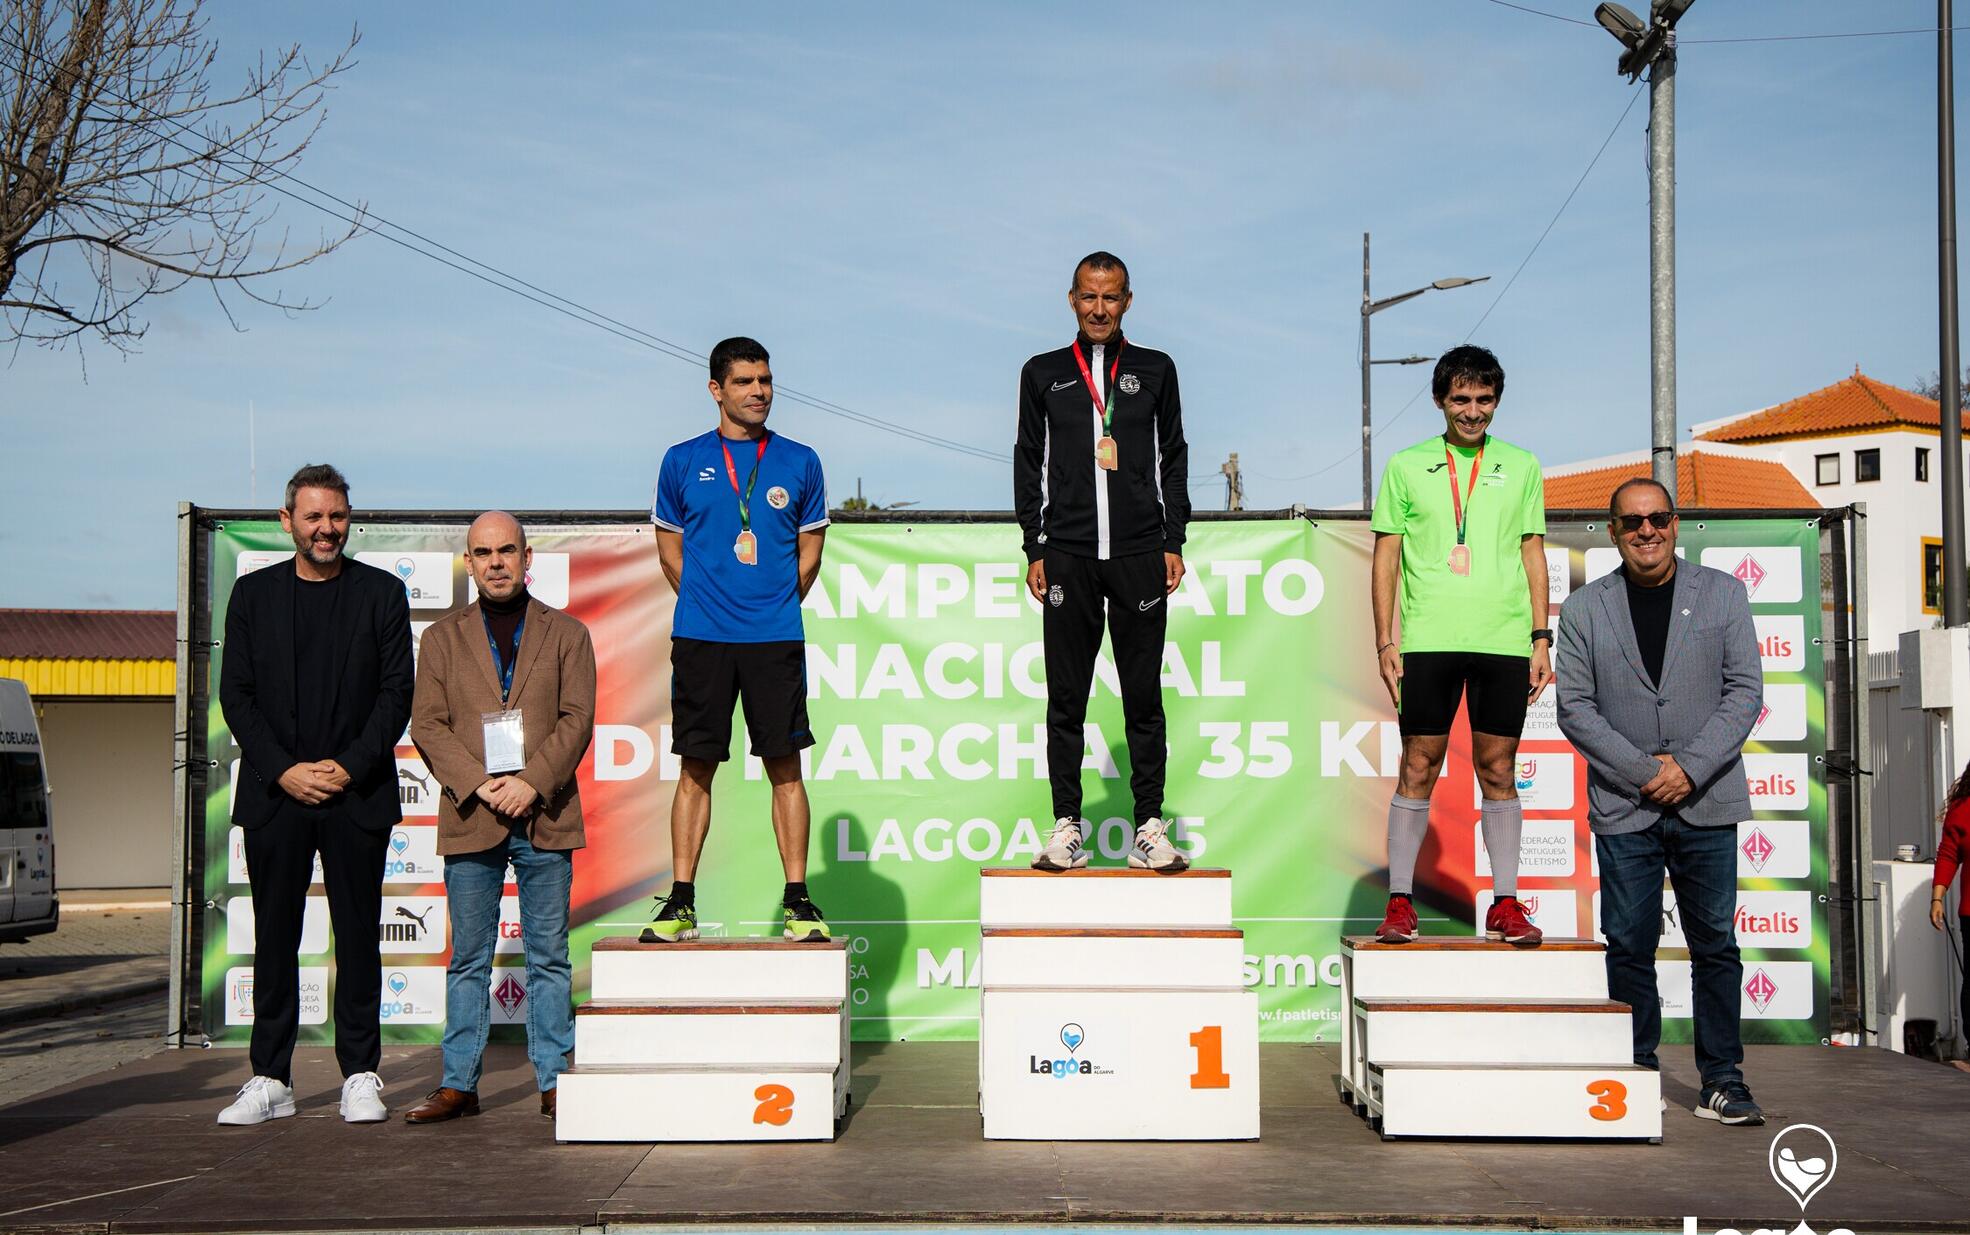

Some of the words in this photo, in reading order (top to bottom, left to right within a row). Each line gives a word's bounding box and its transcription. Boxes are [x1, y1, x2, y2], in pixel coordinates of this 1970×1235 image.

[800, 558, 1324, 619] AMPEATO
[1197, 721, 1293, 778] 35
[836, 817, 1044, 862] LAGOA
[1080, 816, 1207, 861] 205
[1520, 835, 1567, 845] EDERAÇÃO
[1030, 1055, 1092, 1079] Lagoa
[1190, 1026, 1230, 1088] 1
[753, 1083, 795, 1126] 2
[1586, 1079, 1627, 1121] 3
